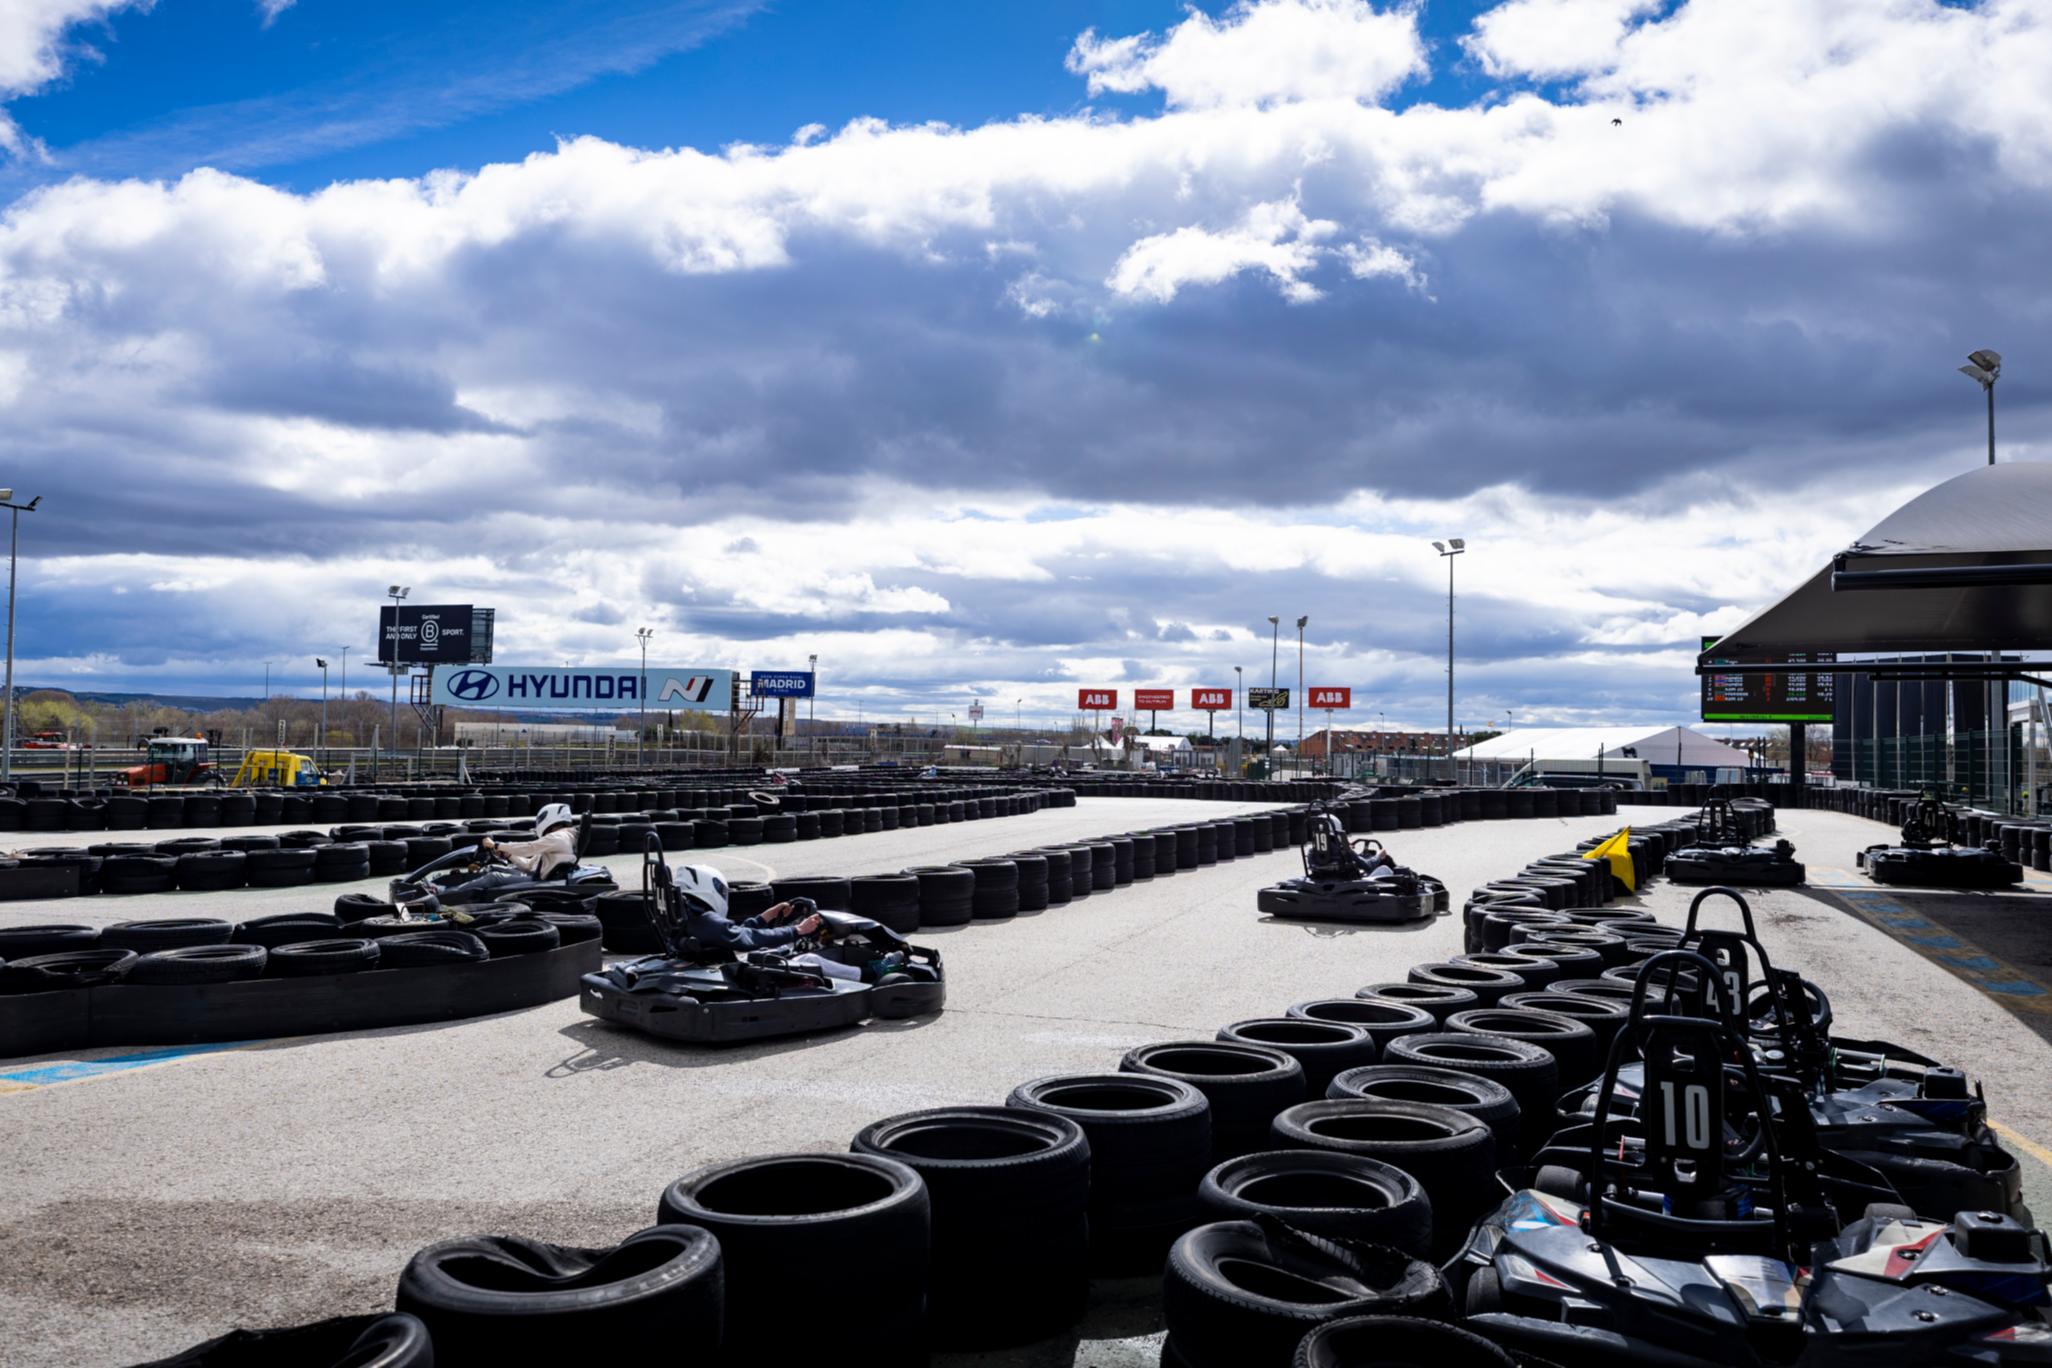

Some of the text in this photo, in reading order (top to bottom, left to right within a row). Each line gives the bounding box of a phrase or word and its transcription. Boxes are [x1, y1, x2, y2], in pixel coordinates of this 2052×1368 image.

[508, 674, 647, 699] HYUNDAI
[758, 679, 806, 689] MADRID
[1085, 694, 1110, 705] ABB
[1199, 693, 1225, 704] ABB
[1316, 692, 1344, 703] ABB
[1315, 833, 1327, 851] 19
[1706, 971, 1741, 1016] 43
[1660, 1081, 1710, 1149] 10
